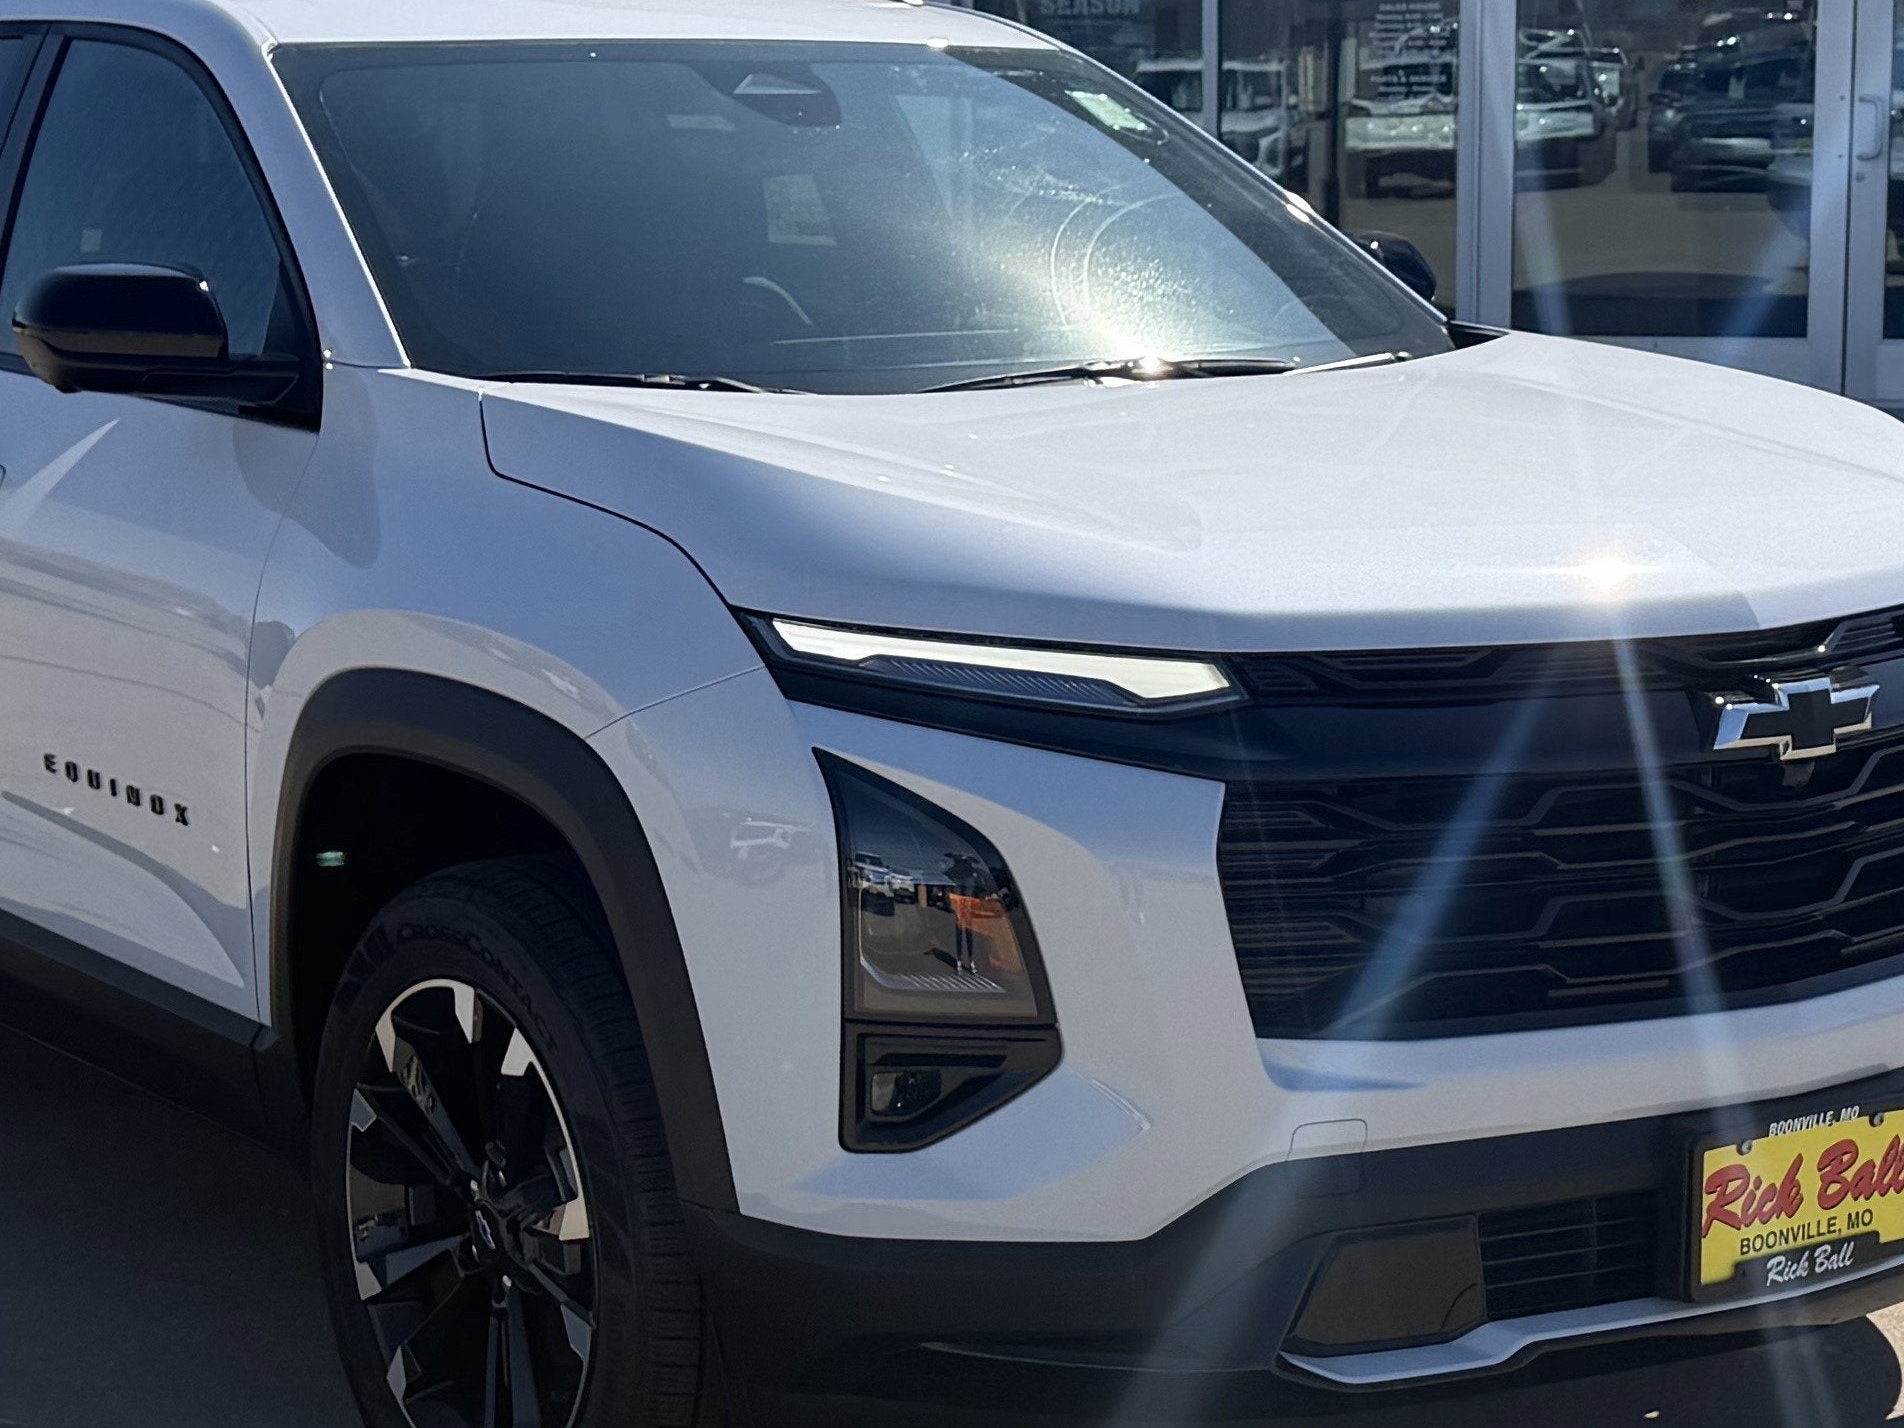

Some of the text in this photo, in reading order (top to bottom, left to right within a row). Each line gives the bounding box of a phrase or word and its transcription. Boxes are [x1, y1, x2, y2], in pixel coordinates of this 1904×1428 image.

[42, 752, 190, 827] EQUINOX
[1840, 1105, 1860, 1122] MO
[1702, 1152, 1804, 1239] Rick
[1739, 1208, 1873, 1256] BOONVILLE, MO
[1766, 1242, 1854, 1287] Rick Ball
